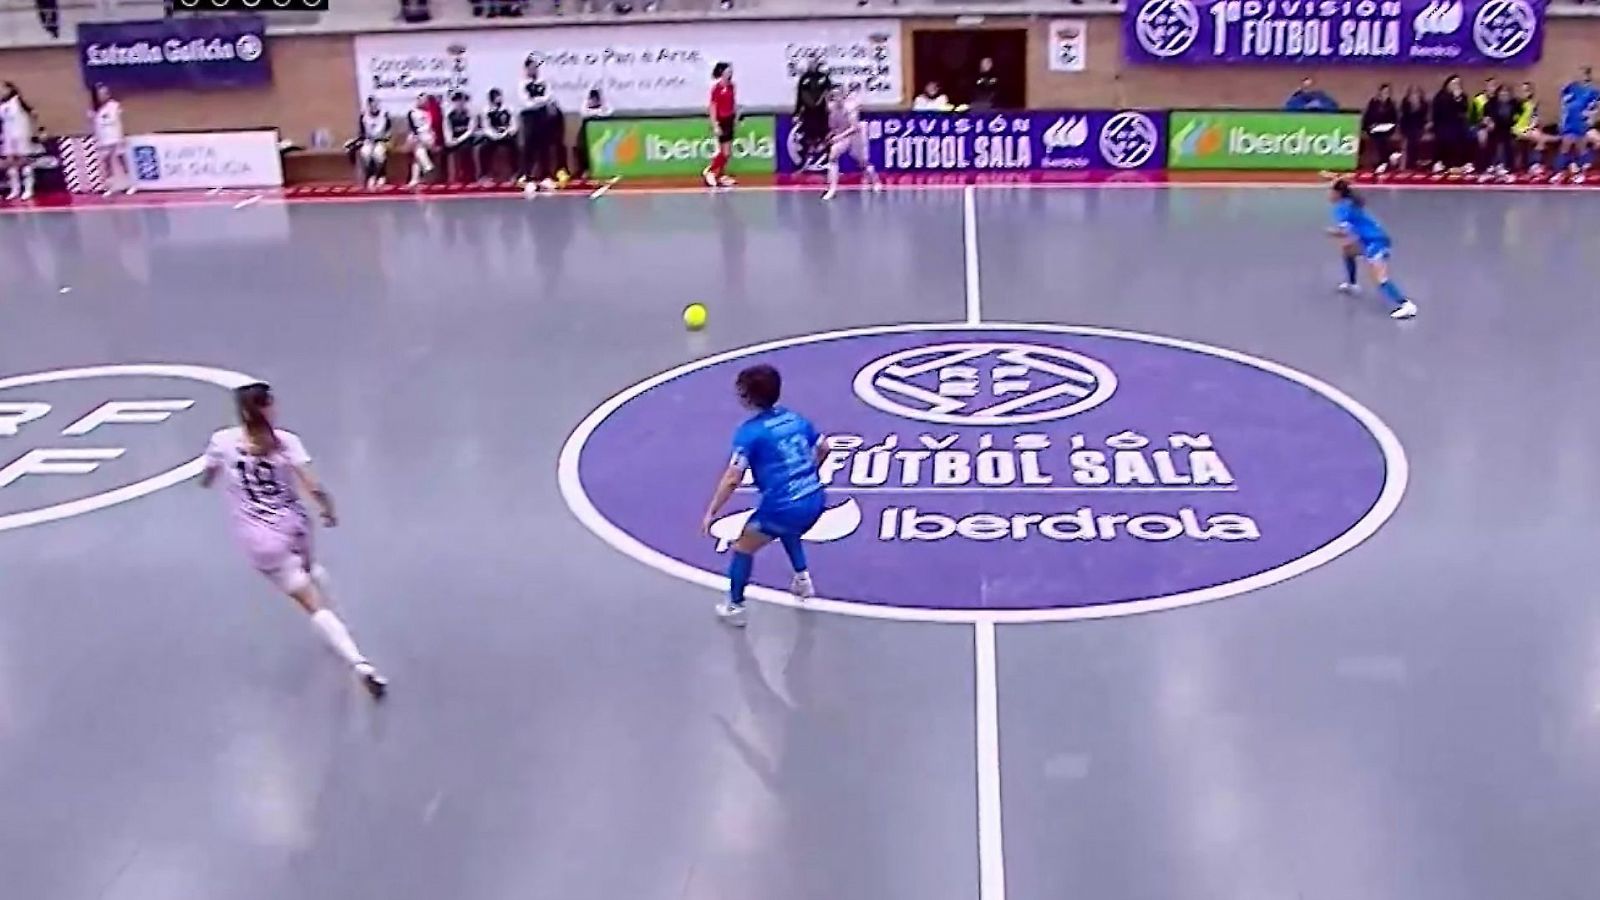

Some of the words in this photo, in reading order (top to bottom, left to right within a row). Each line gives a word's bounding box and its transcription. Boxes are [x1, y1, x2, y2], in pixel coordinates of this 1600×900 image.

[1242, 17, 1333, 56] FÚTBOL
[1338, 18, 1400, 56] SALA
[645, 131, 774, 162] Iberdola
[884, 136, 970, 169] FÚTBOL
[974, 136, 1032, 169] SALA
[1229, 126, 1359, 157] Iberdrola
[817, 449, 1053, 487] FÚTBOL
[1072, 450, 1237, 487] SALA
[877, 505, 1262, 543] Iberdrola
